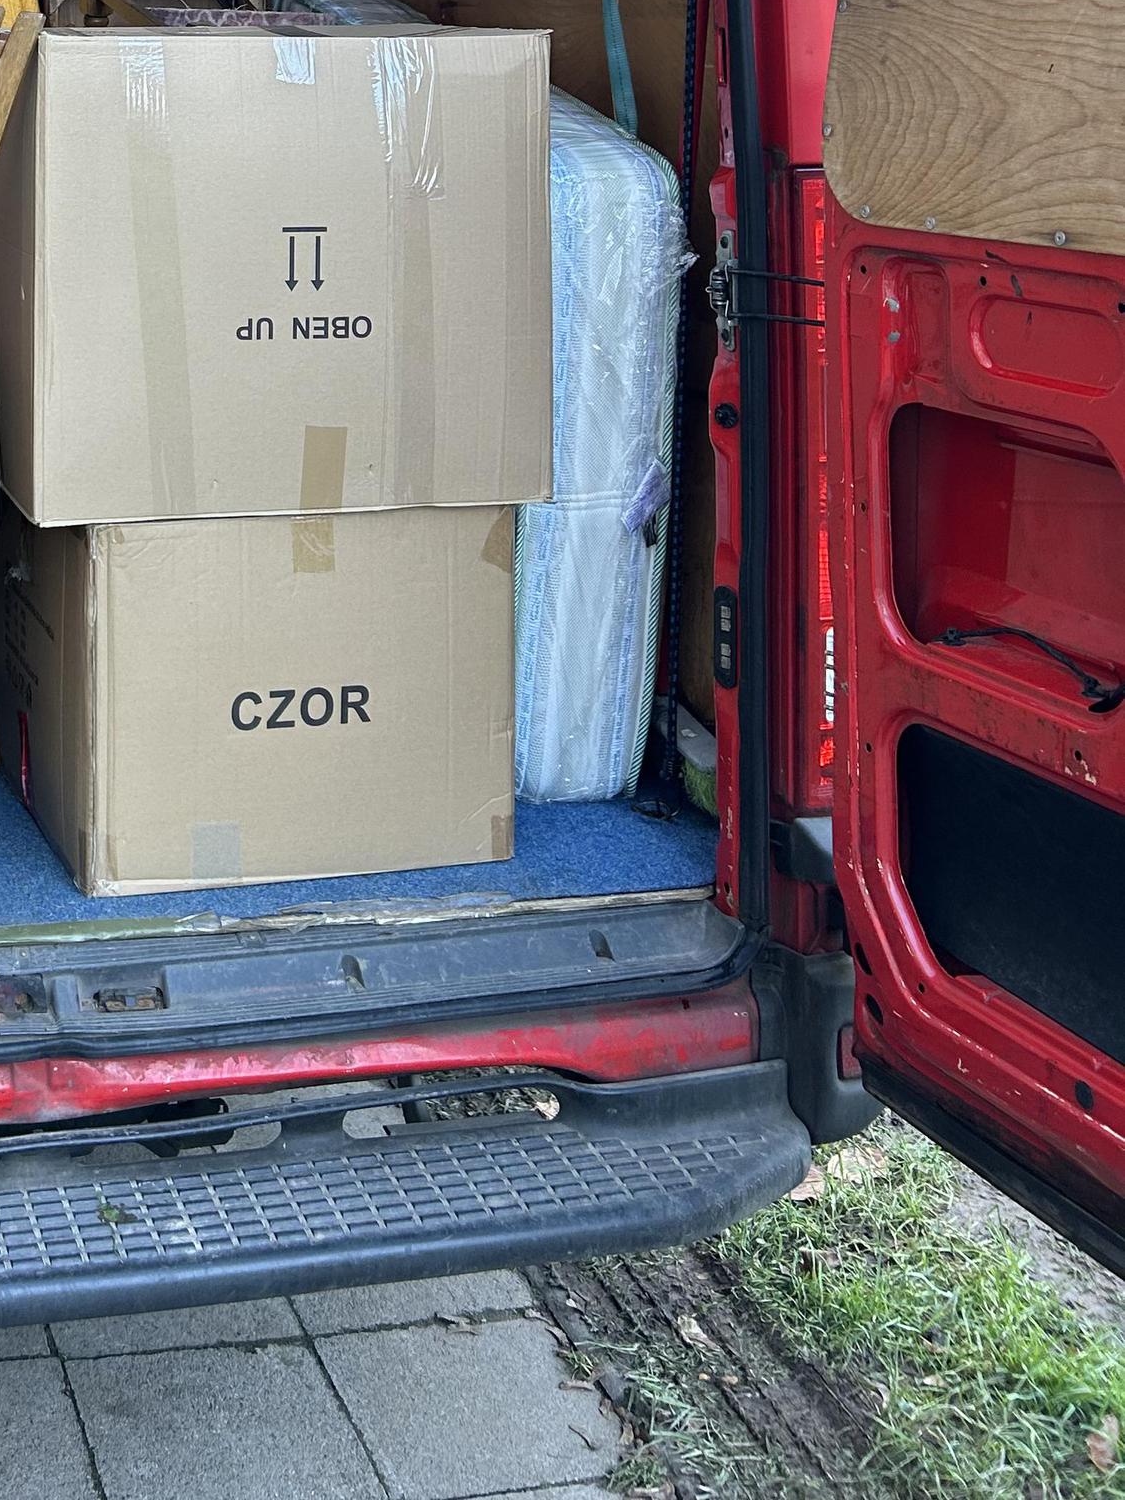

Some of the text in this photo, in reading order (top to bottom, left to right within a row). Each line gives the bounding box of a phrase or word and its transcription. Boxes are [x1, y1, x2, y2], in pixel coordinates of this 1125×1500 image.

[236, 315, 372, 340] OBEN UP
[231, 685, 371, 731] CZOR
